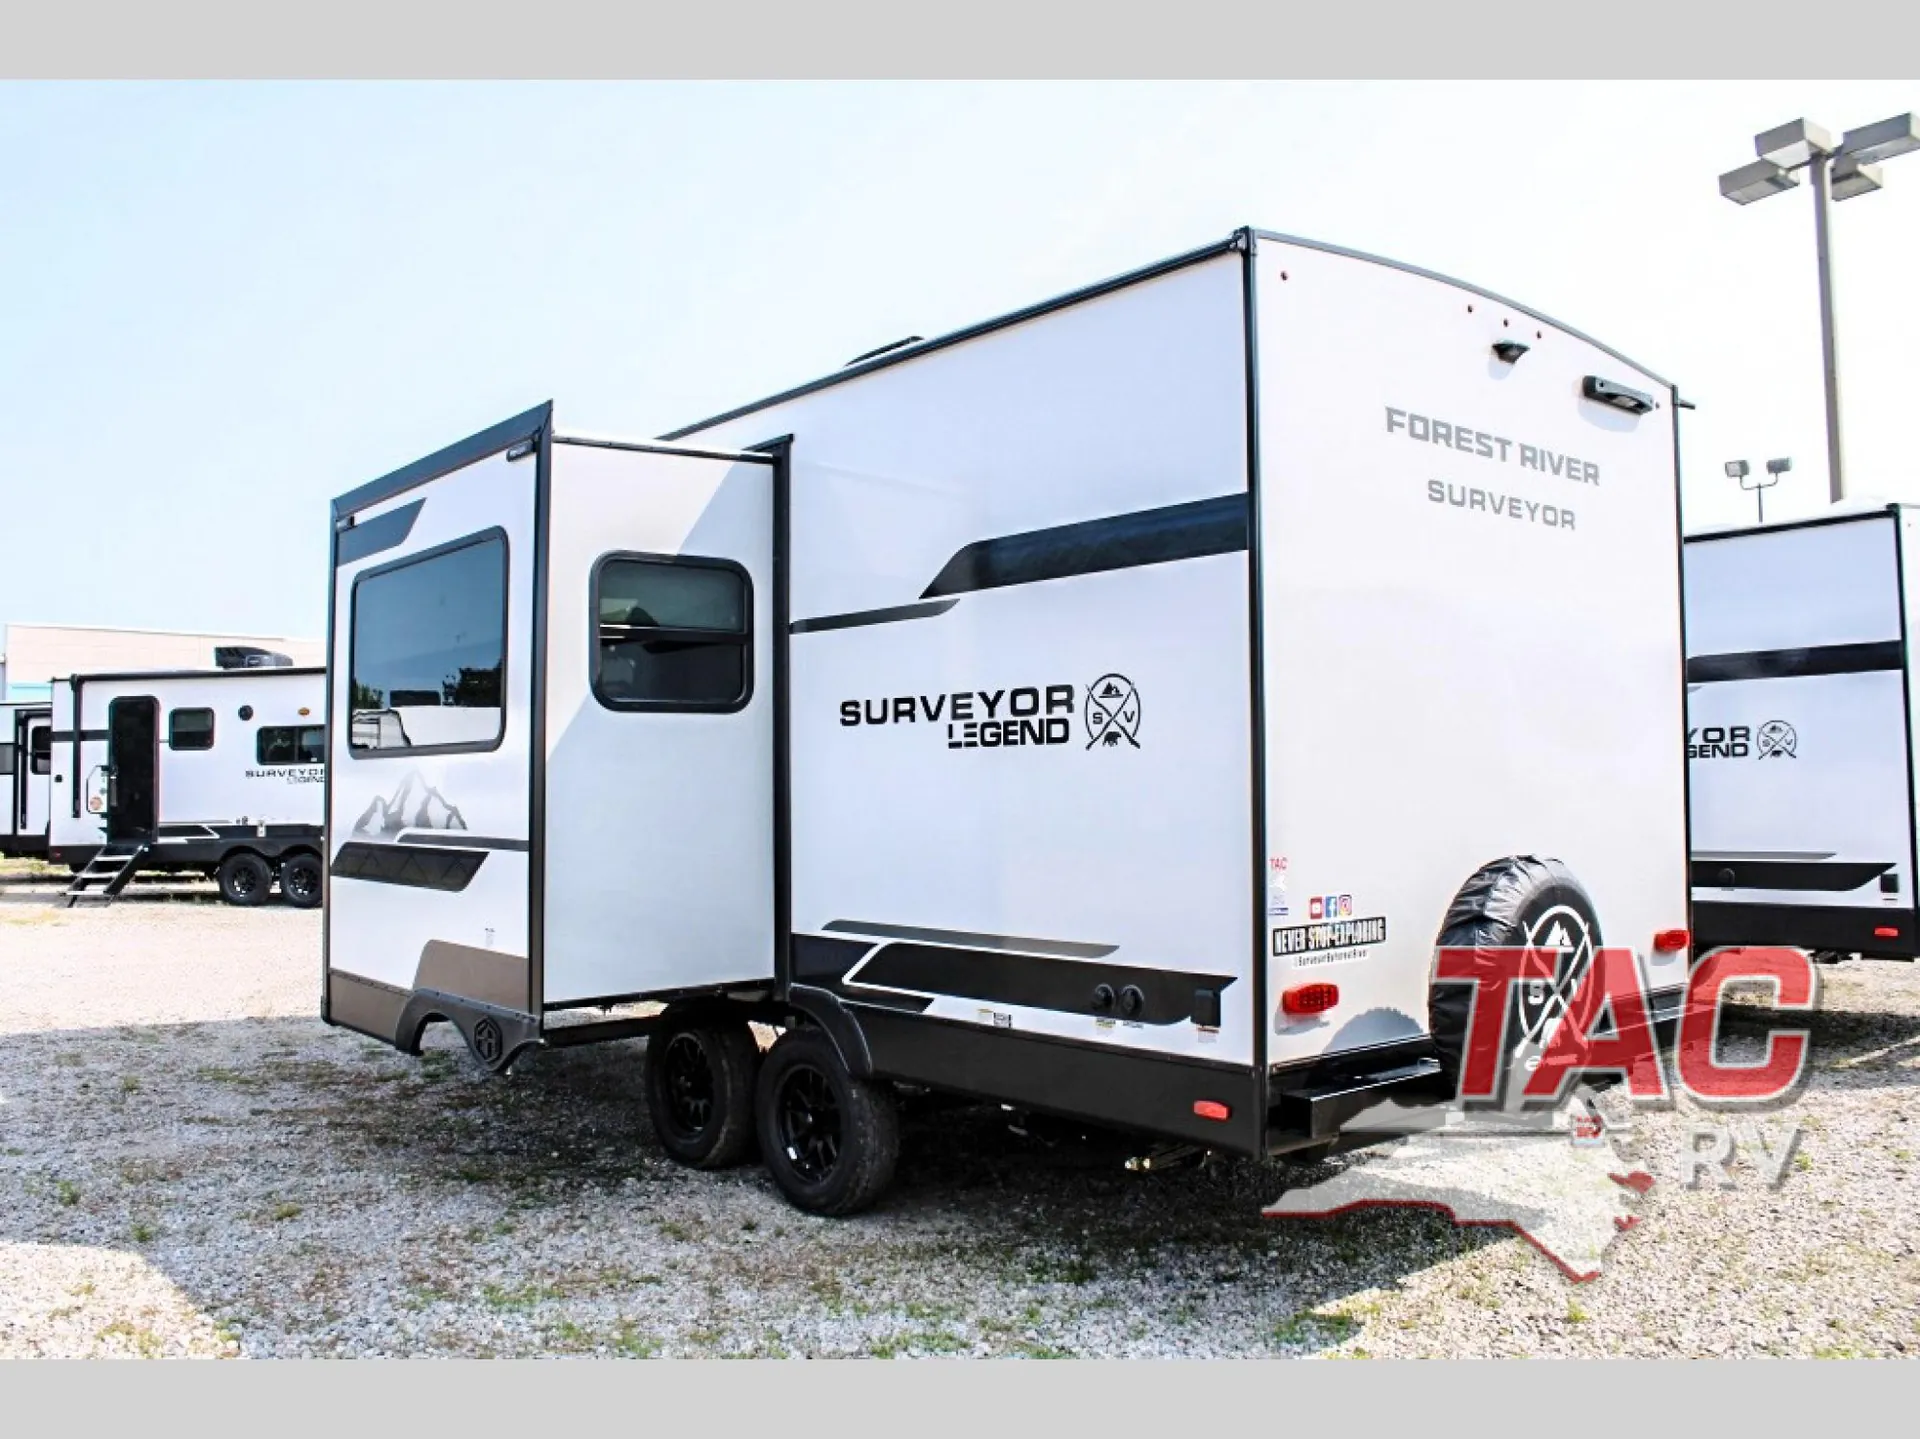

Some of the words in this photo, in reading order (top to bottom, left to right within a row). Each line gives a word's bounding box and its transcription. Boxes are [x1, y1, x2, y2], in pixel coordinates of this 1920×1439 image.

[1385, 406, 1512, 463] FOREST
[1518, 442, 1601, 487] RIVER
[1427, 479, 1577, 531] SURVEYOR
[839, 684, 1076, 727] SURVEYOR
[947, 717, 1070, 750] LEGEND
[1274, 927, 1306, 954] NEVER
